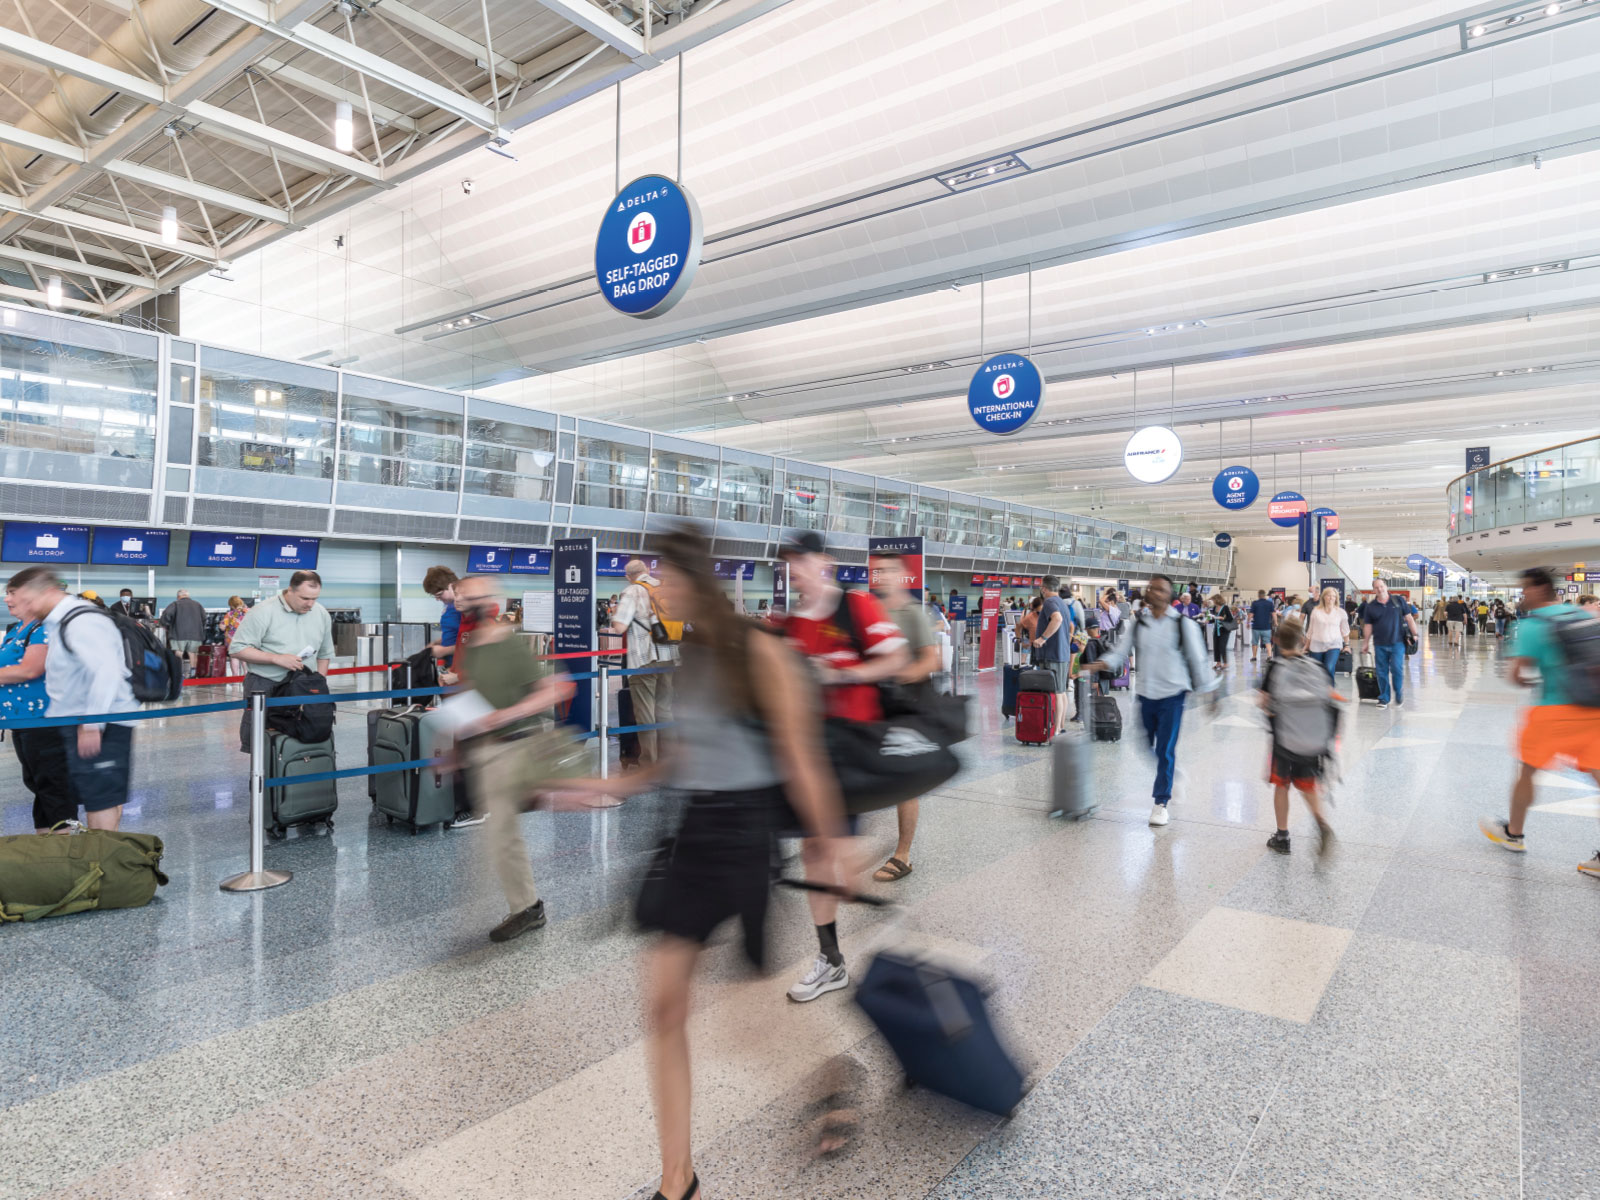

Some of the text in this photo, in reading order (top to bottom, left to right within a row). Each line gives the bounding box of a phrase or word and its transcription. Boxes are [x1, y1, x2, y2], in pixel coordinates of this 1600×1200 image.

[627, 190, 659, 208] DELTA
[606, 253, 679, 284] SELF-TAGGED
[614, 272, 670, 298] BAG DROP
[992, 362, 1017, 371] DELTA
[974, 400, 1035, 414] INTERNATIONAL
[985, 411, 1022, 422] CHECK-IN
